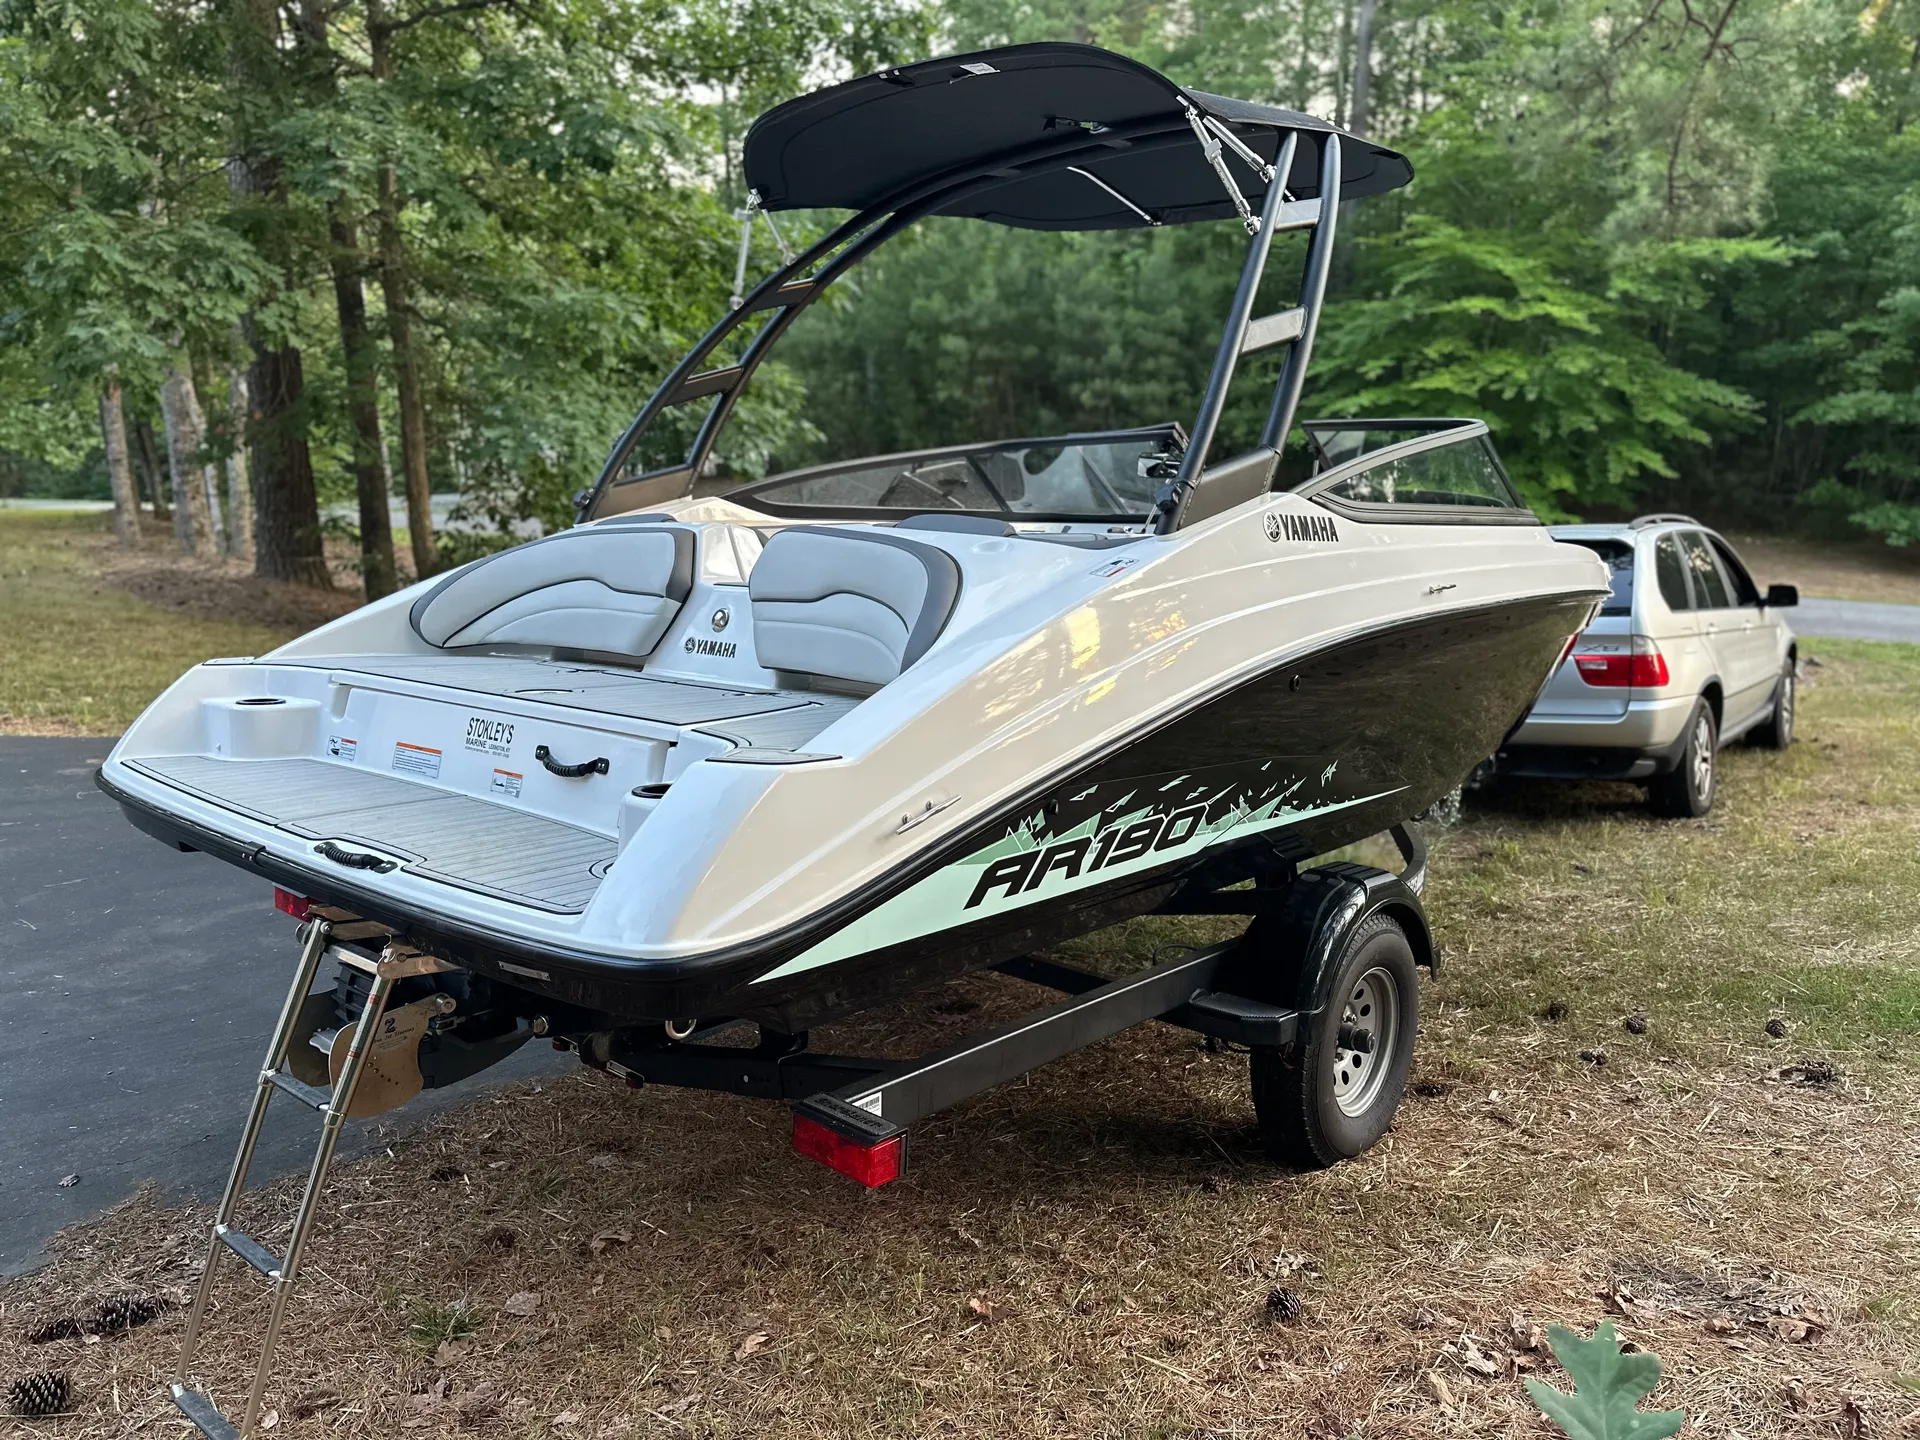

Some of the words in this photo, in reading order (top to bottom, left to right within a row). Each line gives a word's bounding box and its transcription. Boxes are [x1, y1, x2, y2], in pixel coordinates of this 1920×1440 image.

[1279, 513, 1339, 542] YAMAHA
[696, 639, 737, 658] YAMAHA
[467, 717, 514, 744] STOKLEY'S
[465, 737, 487, 748] MARINE
[962, 802, 1209, 911] AR190
[385, 1017, 396, 1034] 2
